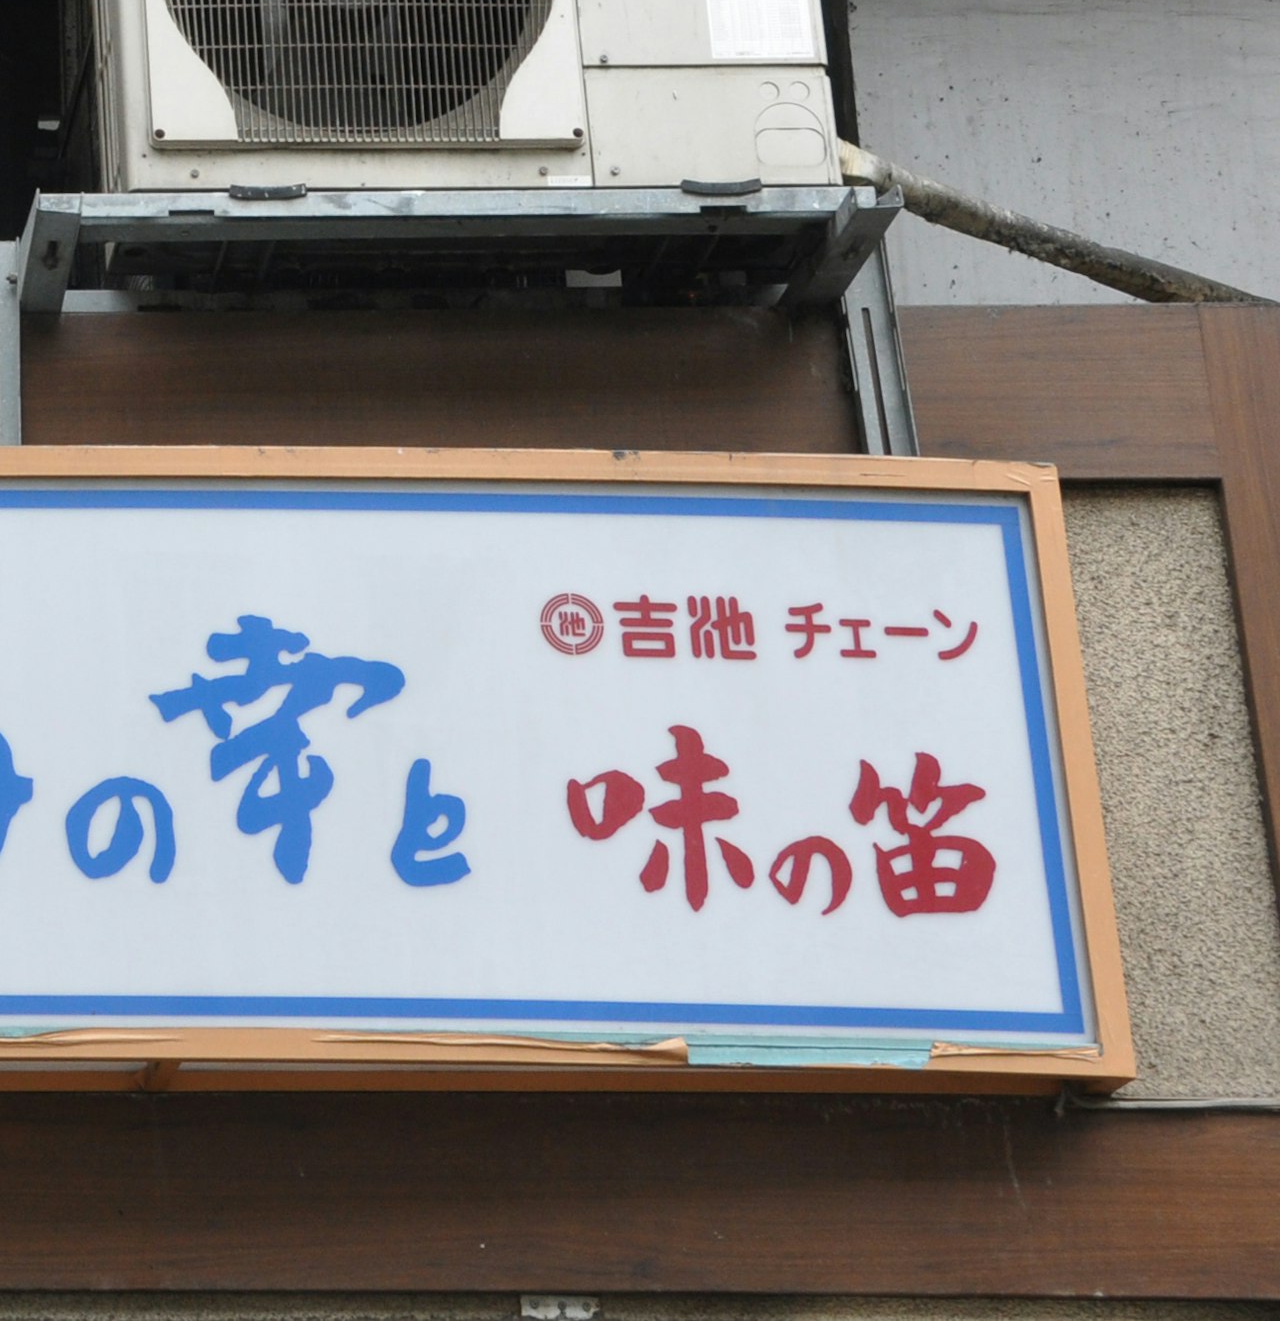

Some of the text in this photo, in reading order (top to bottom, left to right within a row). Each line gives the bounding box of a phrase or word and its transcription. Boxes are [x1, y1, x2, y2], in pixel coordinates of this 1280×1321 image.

[785, 603, 979, 660] チェーン
[567, 725, 997, 918] 味の笛
